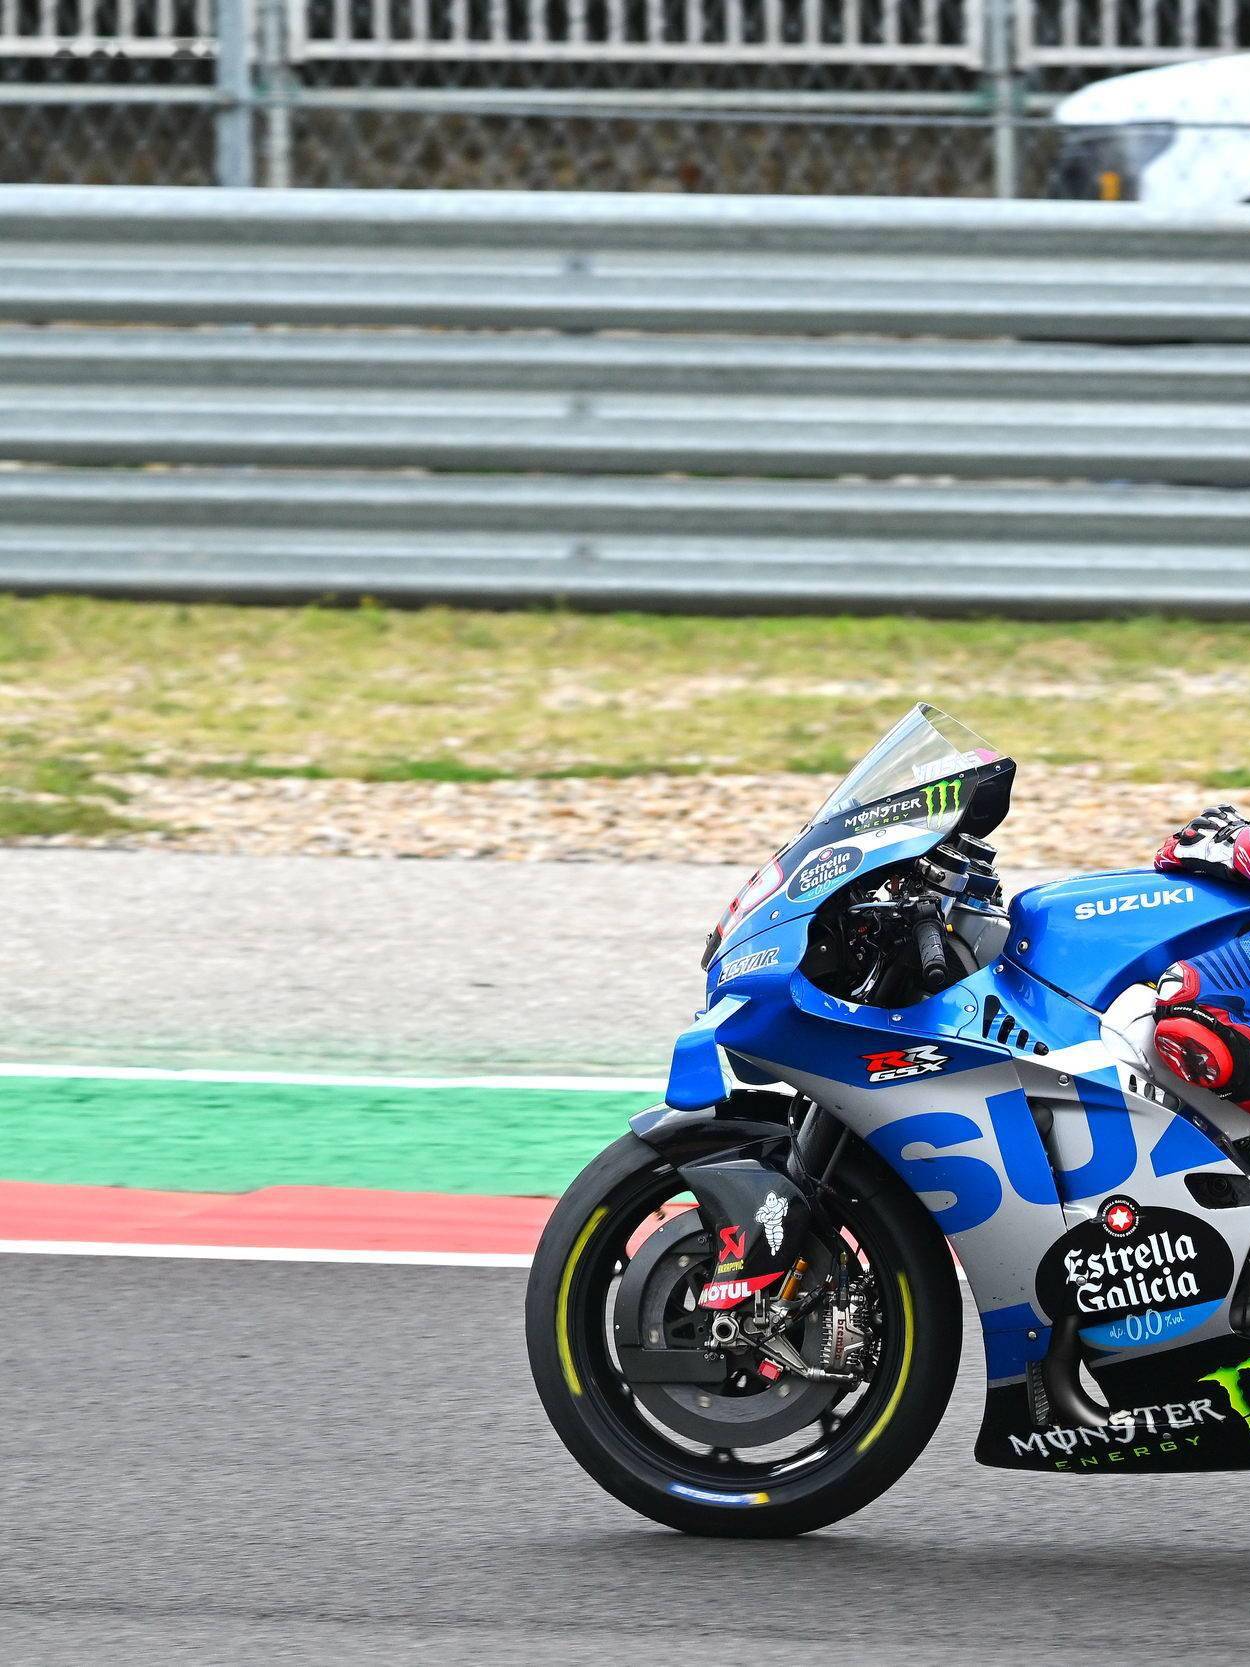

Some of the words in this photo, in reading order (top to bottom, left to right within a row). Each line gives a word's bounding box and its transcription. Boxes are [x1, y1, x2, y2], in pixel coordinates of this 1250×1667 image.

[845, 798, 922, 828] MONSTER
[855, 814, 909, 832] ENERGY
[799, 852, 851, 882] Estrella
[801, 864, 847, 892] Galicia
[1074, 887, 1195, 921] SUZUKI
[717, 946, 780, 987] ECSTAR
[869, 1059, 948, 1083] GSX
[1064, 1230, 1198, 1285] Estrella
[698, 1281, 752, 1305] MOTUL
[1077, 1267, 1200, 1313] Galicia
[835, 1317, 846, 1361] brembo
[1008, 1397, 1227, 1458] MONSTER
[1055, 1435, 1200, 1471] ENERGY
